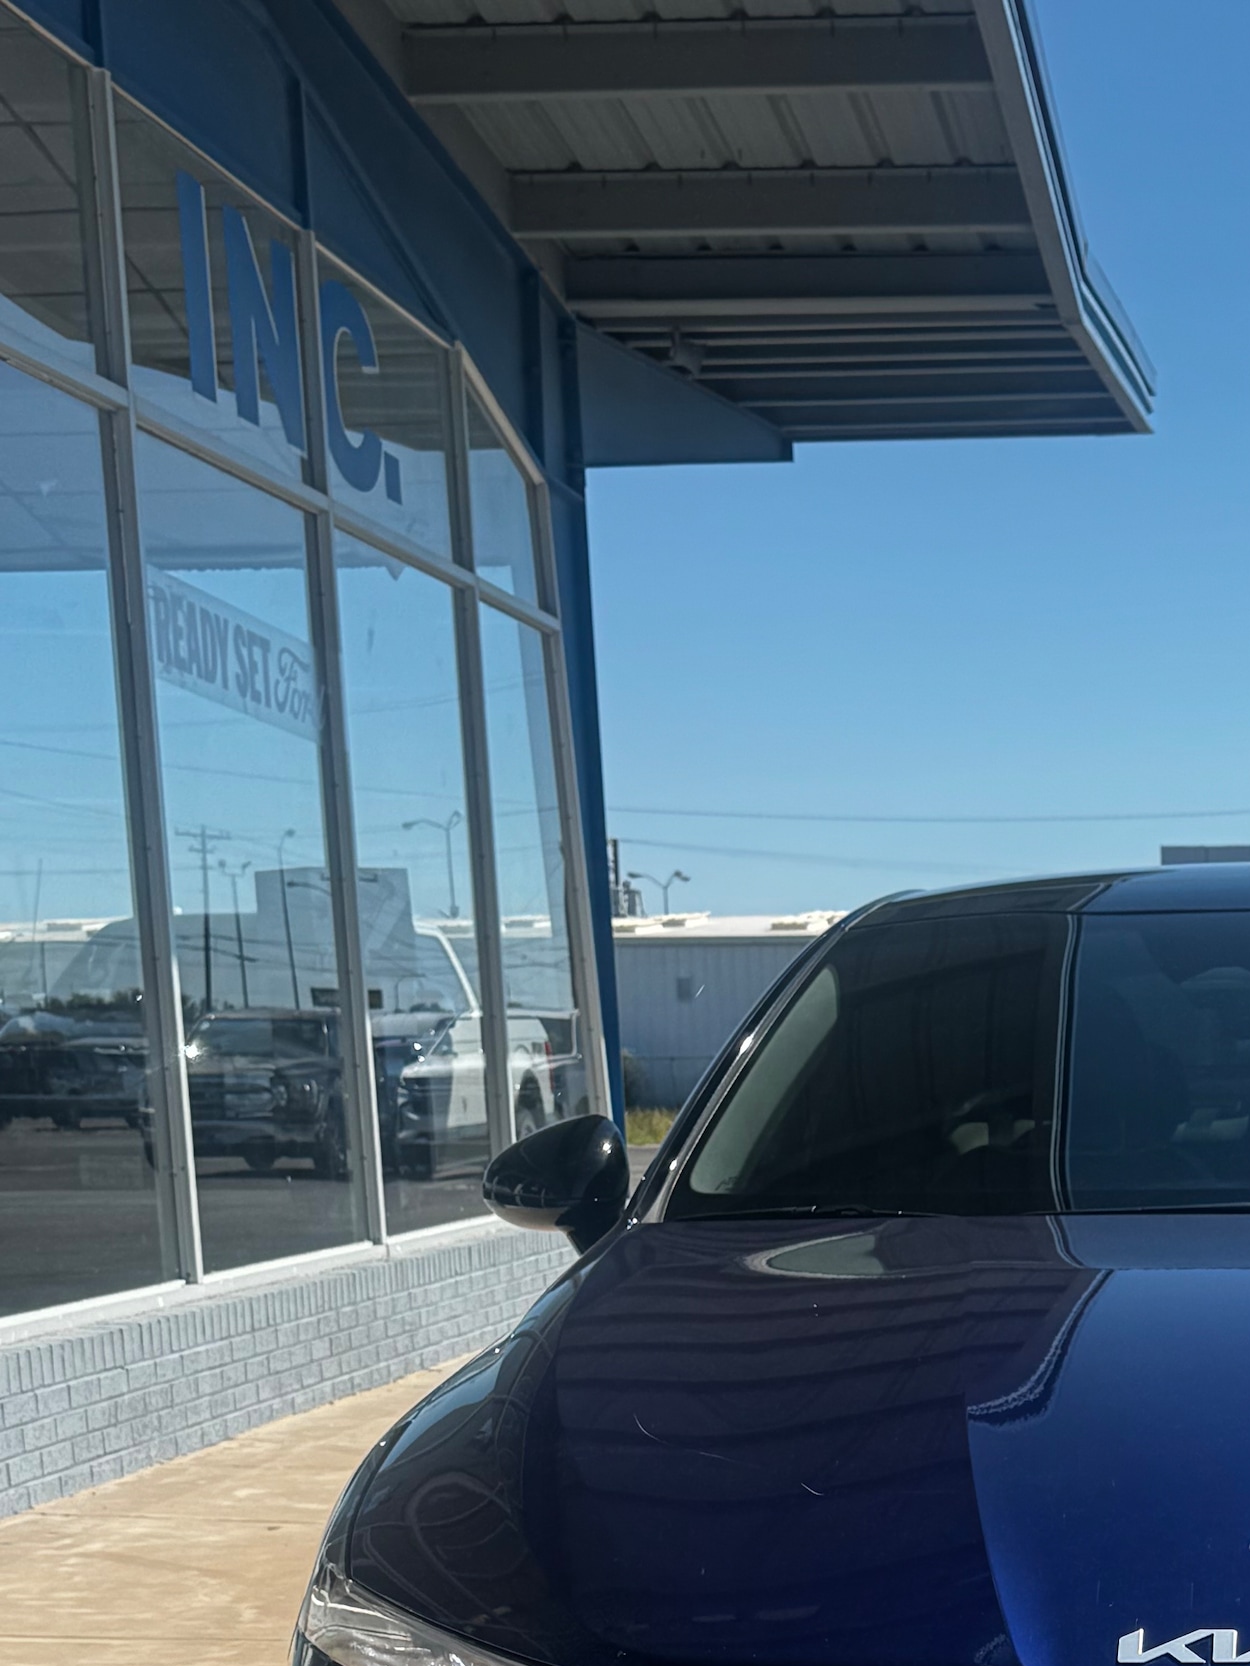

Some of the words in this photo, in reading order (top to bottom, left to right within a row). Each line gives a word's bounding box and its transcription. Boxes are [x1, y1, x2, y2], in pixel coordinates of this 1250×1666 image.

[177, 170, 403, 506] INC.
[150, 584, 229, 691] READY
[233, 624, 272, 709] SET
